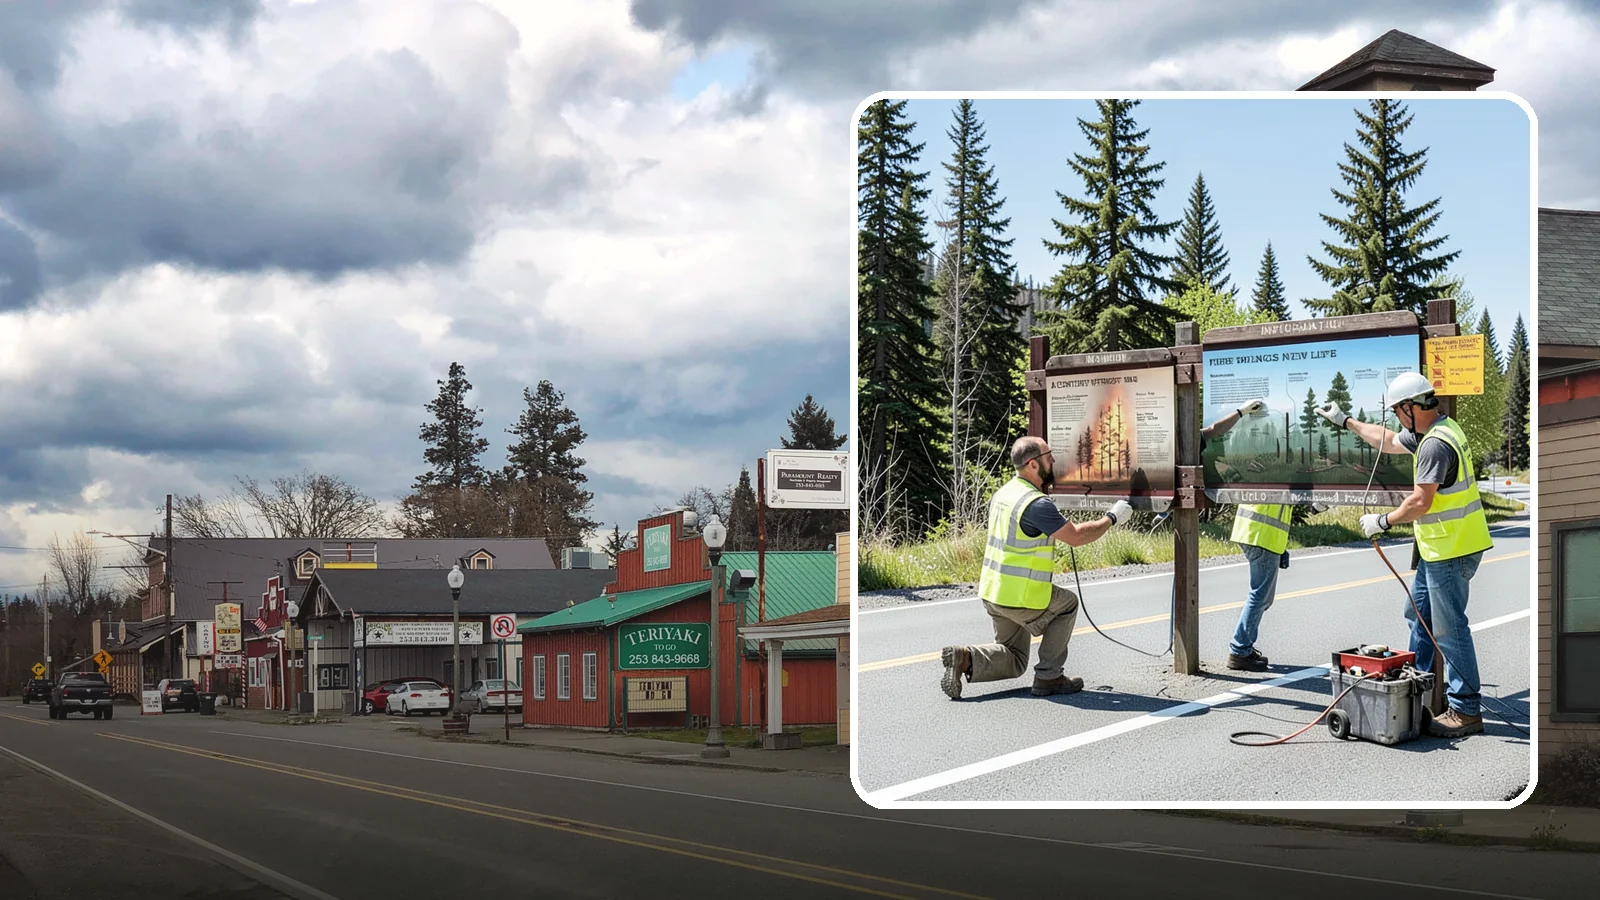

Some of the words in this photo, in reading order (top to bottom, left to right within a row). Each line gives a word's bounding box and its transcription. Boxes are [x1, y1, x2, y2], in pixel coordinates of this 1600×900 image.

[624, 627, 702, 646] TERIYAKI
[629, 654, 649, 664] 253
[651, 654, 700, 664] 843-9668
